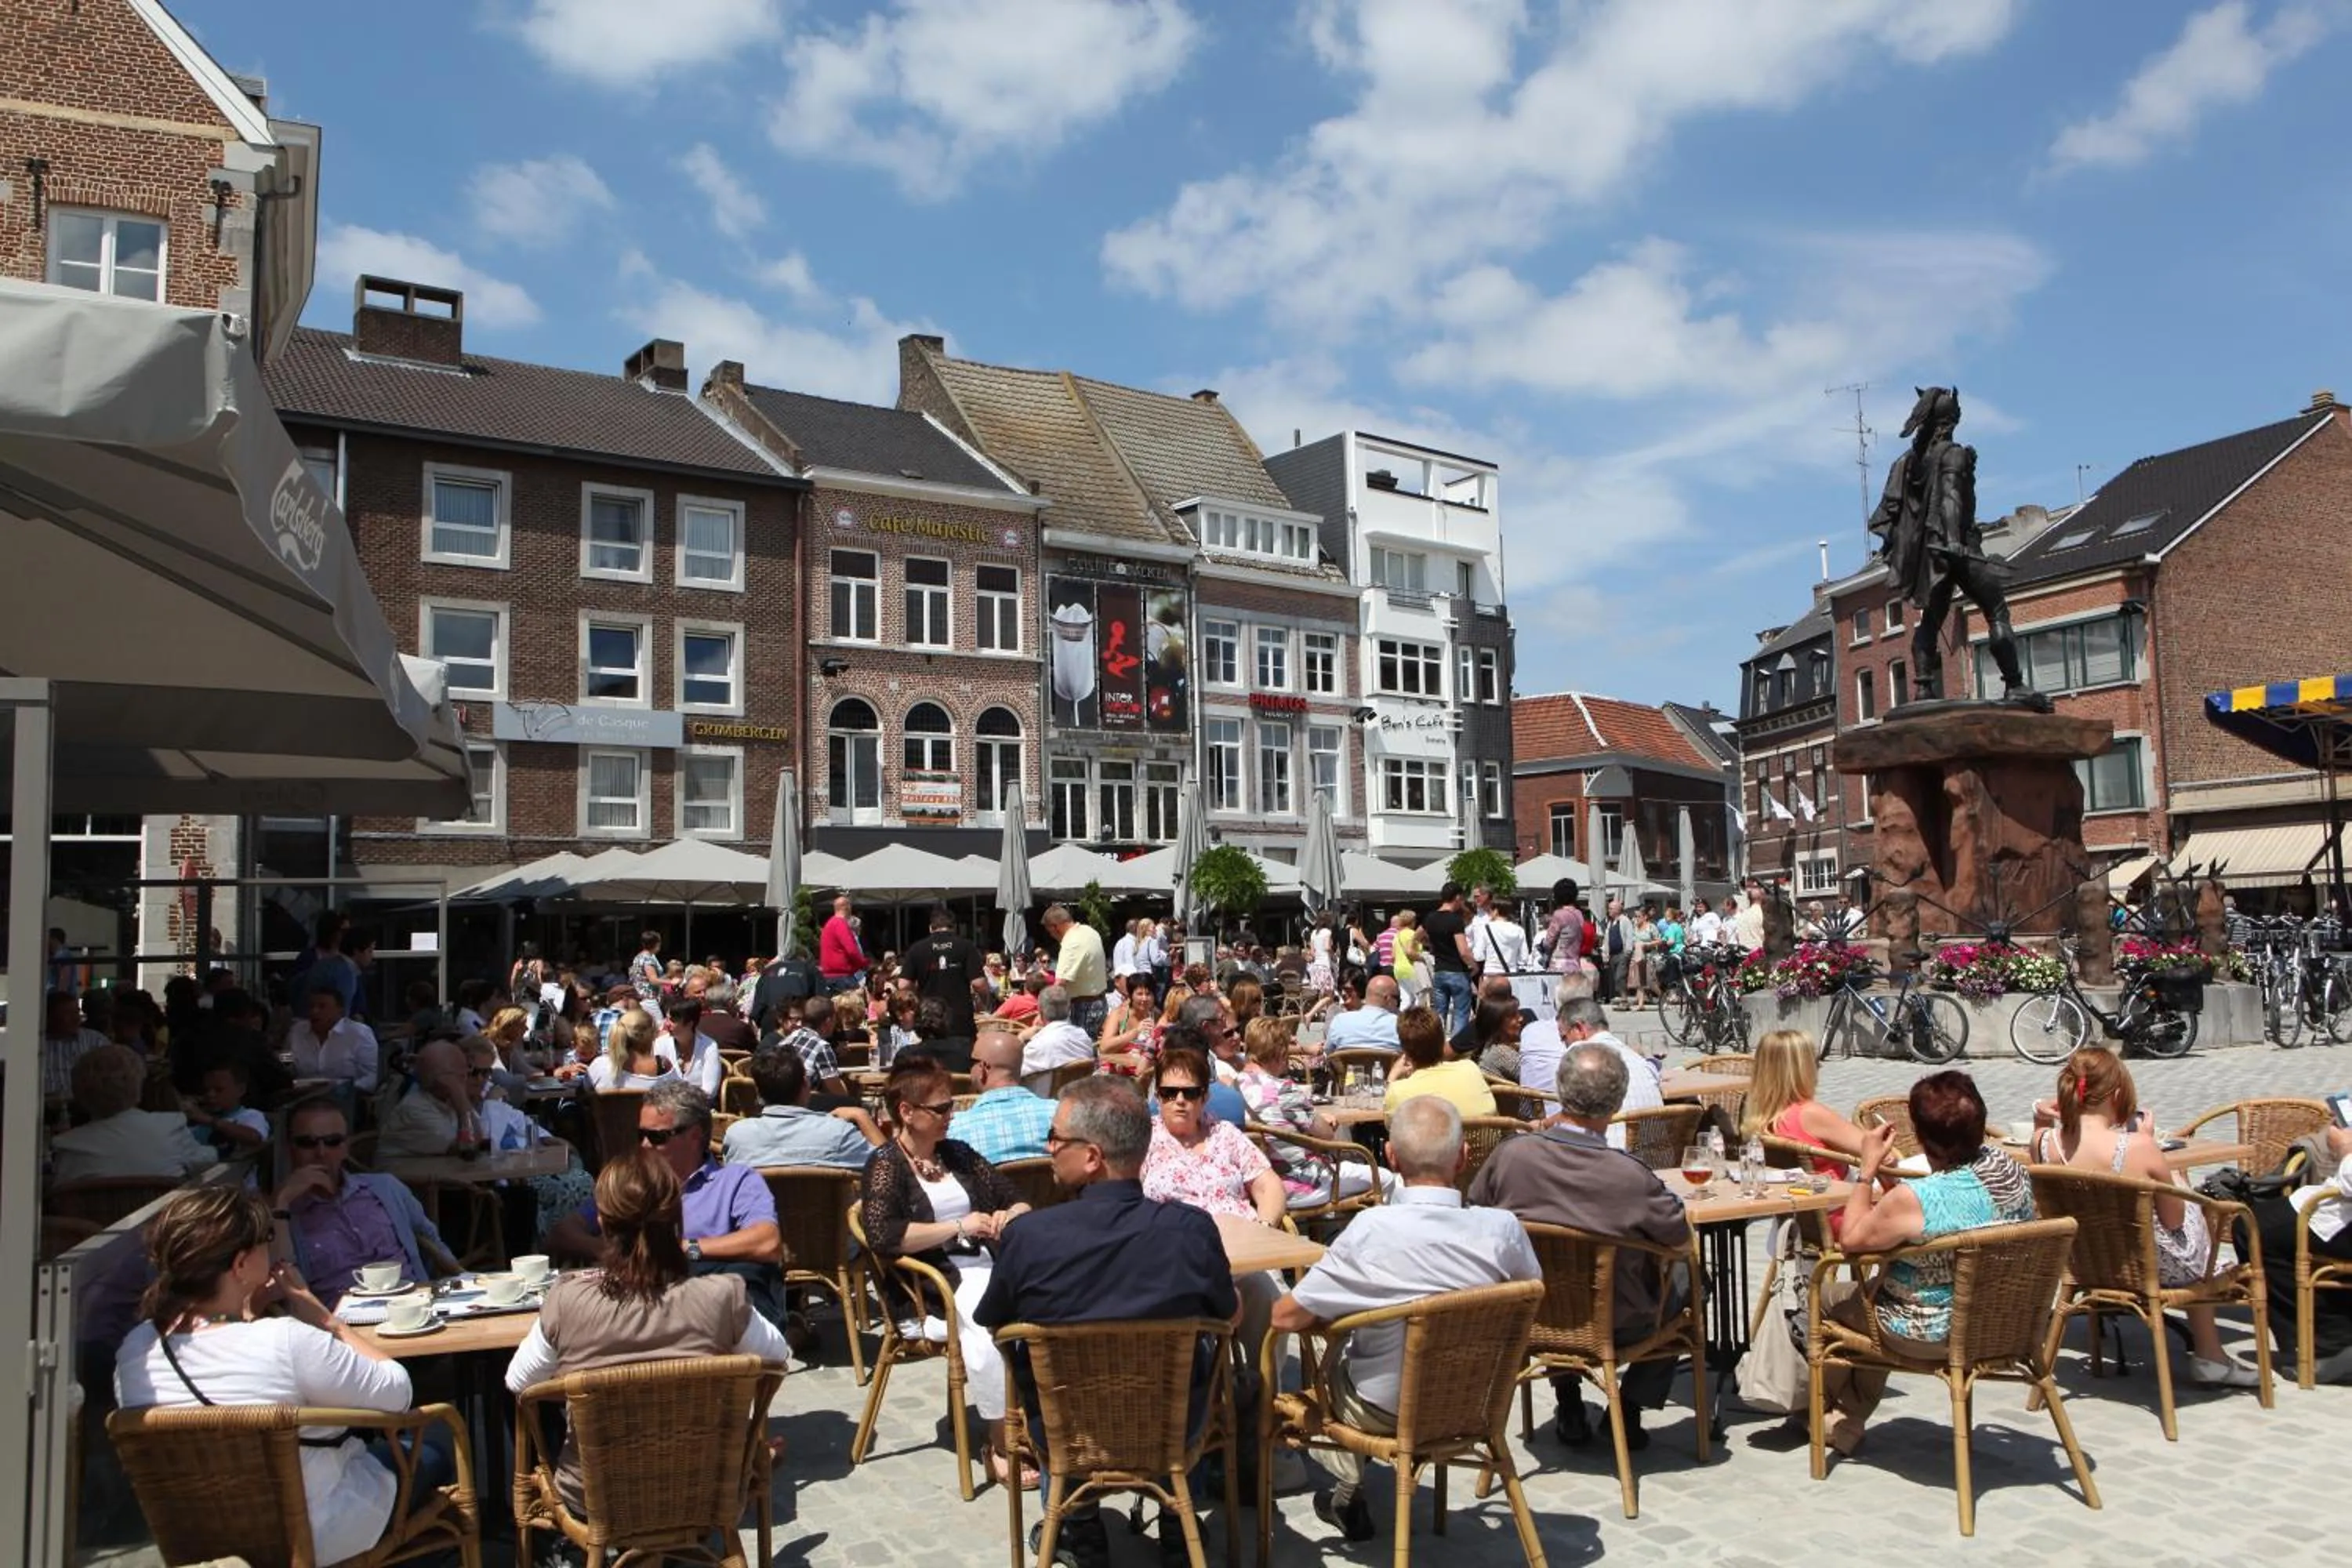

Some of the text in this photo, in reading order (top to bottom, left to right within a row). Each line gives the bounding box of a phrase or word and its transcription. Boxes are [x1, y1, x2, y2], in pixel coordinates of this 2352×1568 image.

[270, 463, 328, 571] Carlsberg
[916, 516, 986, 542] Majestic
[692, 722, 788, 739] GRIMBERGEN
